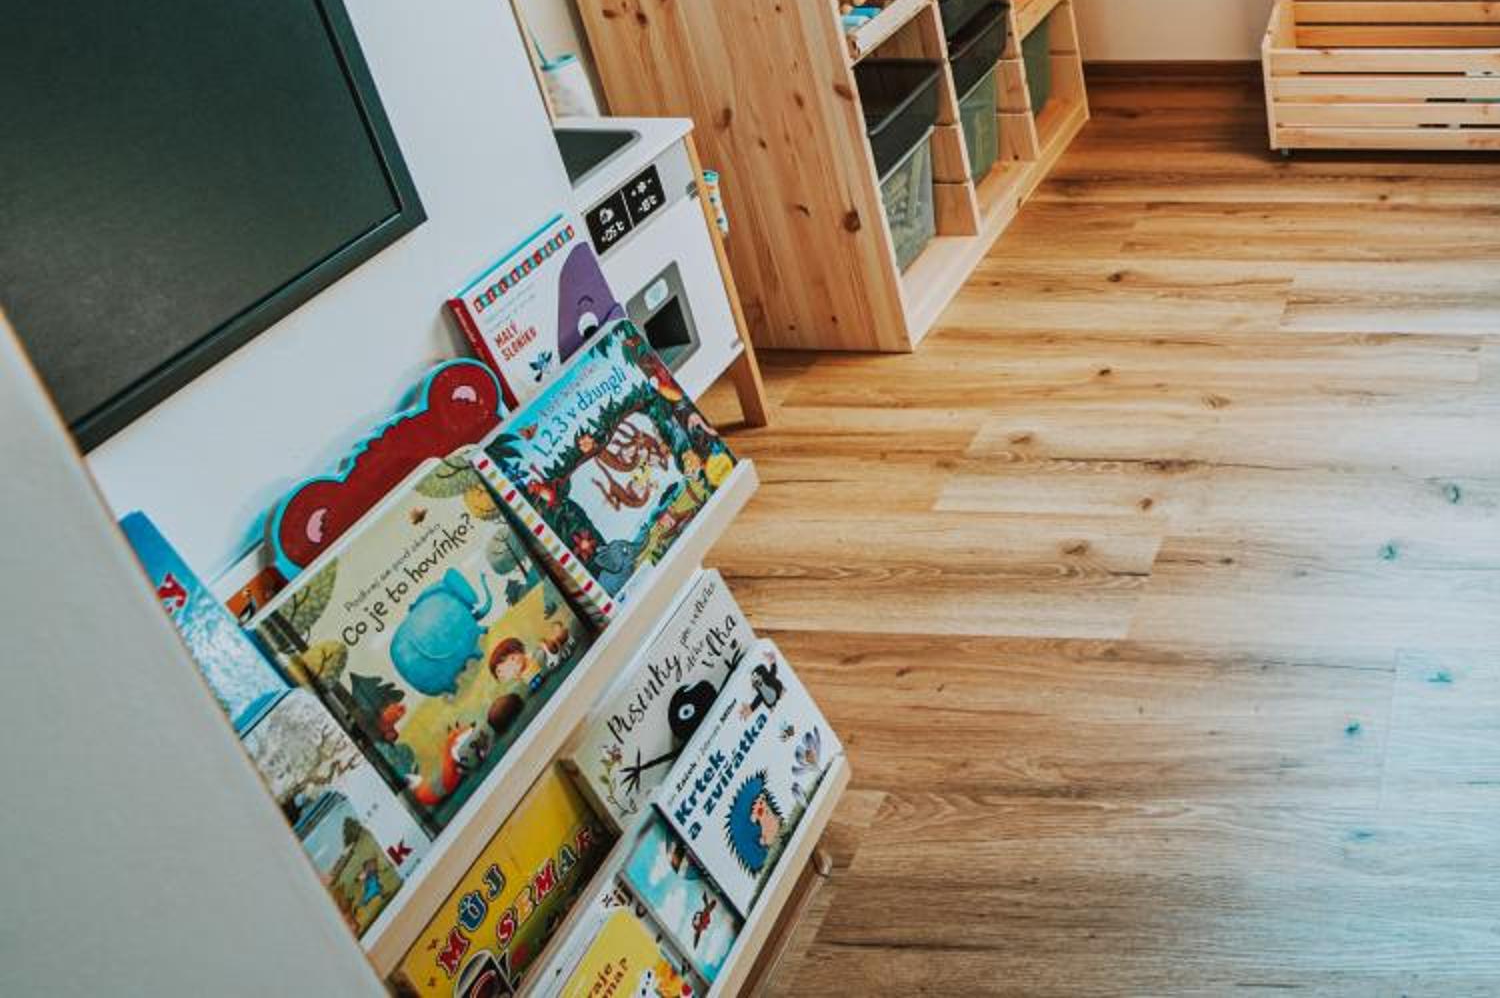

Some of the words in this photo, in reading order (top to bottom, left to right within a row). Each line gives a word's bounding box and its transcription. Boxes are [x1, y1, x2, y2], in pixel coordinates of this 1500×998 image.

[342, 621, 368, 646] Co
[363, 601, 389, 632] je
[385, 581, 409, 603] to
[403, 512, 475, 583] hovínko?
[606, 654, 683, 744] Pusinky
[673, 749, 726, 826] Krtek
[688, 821, 702, 840] a
[703, 713, 768, 816] zvířátka
